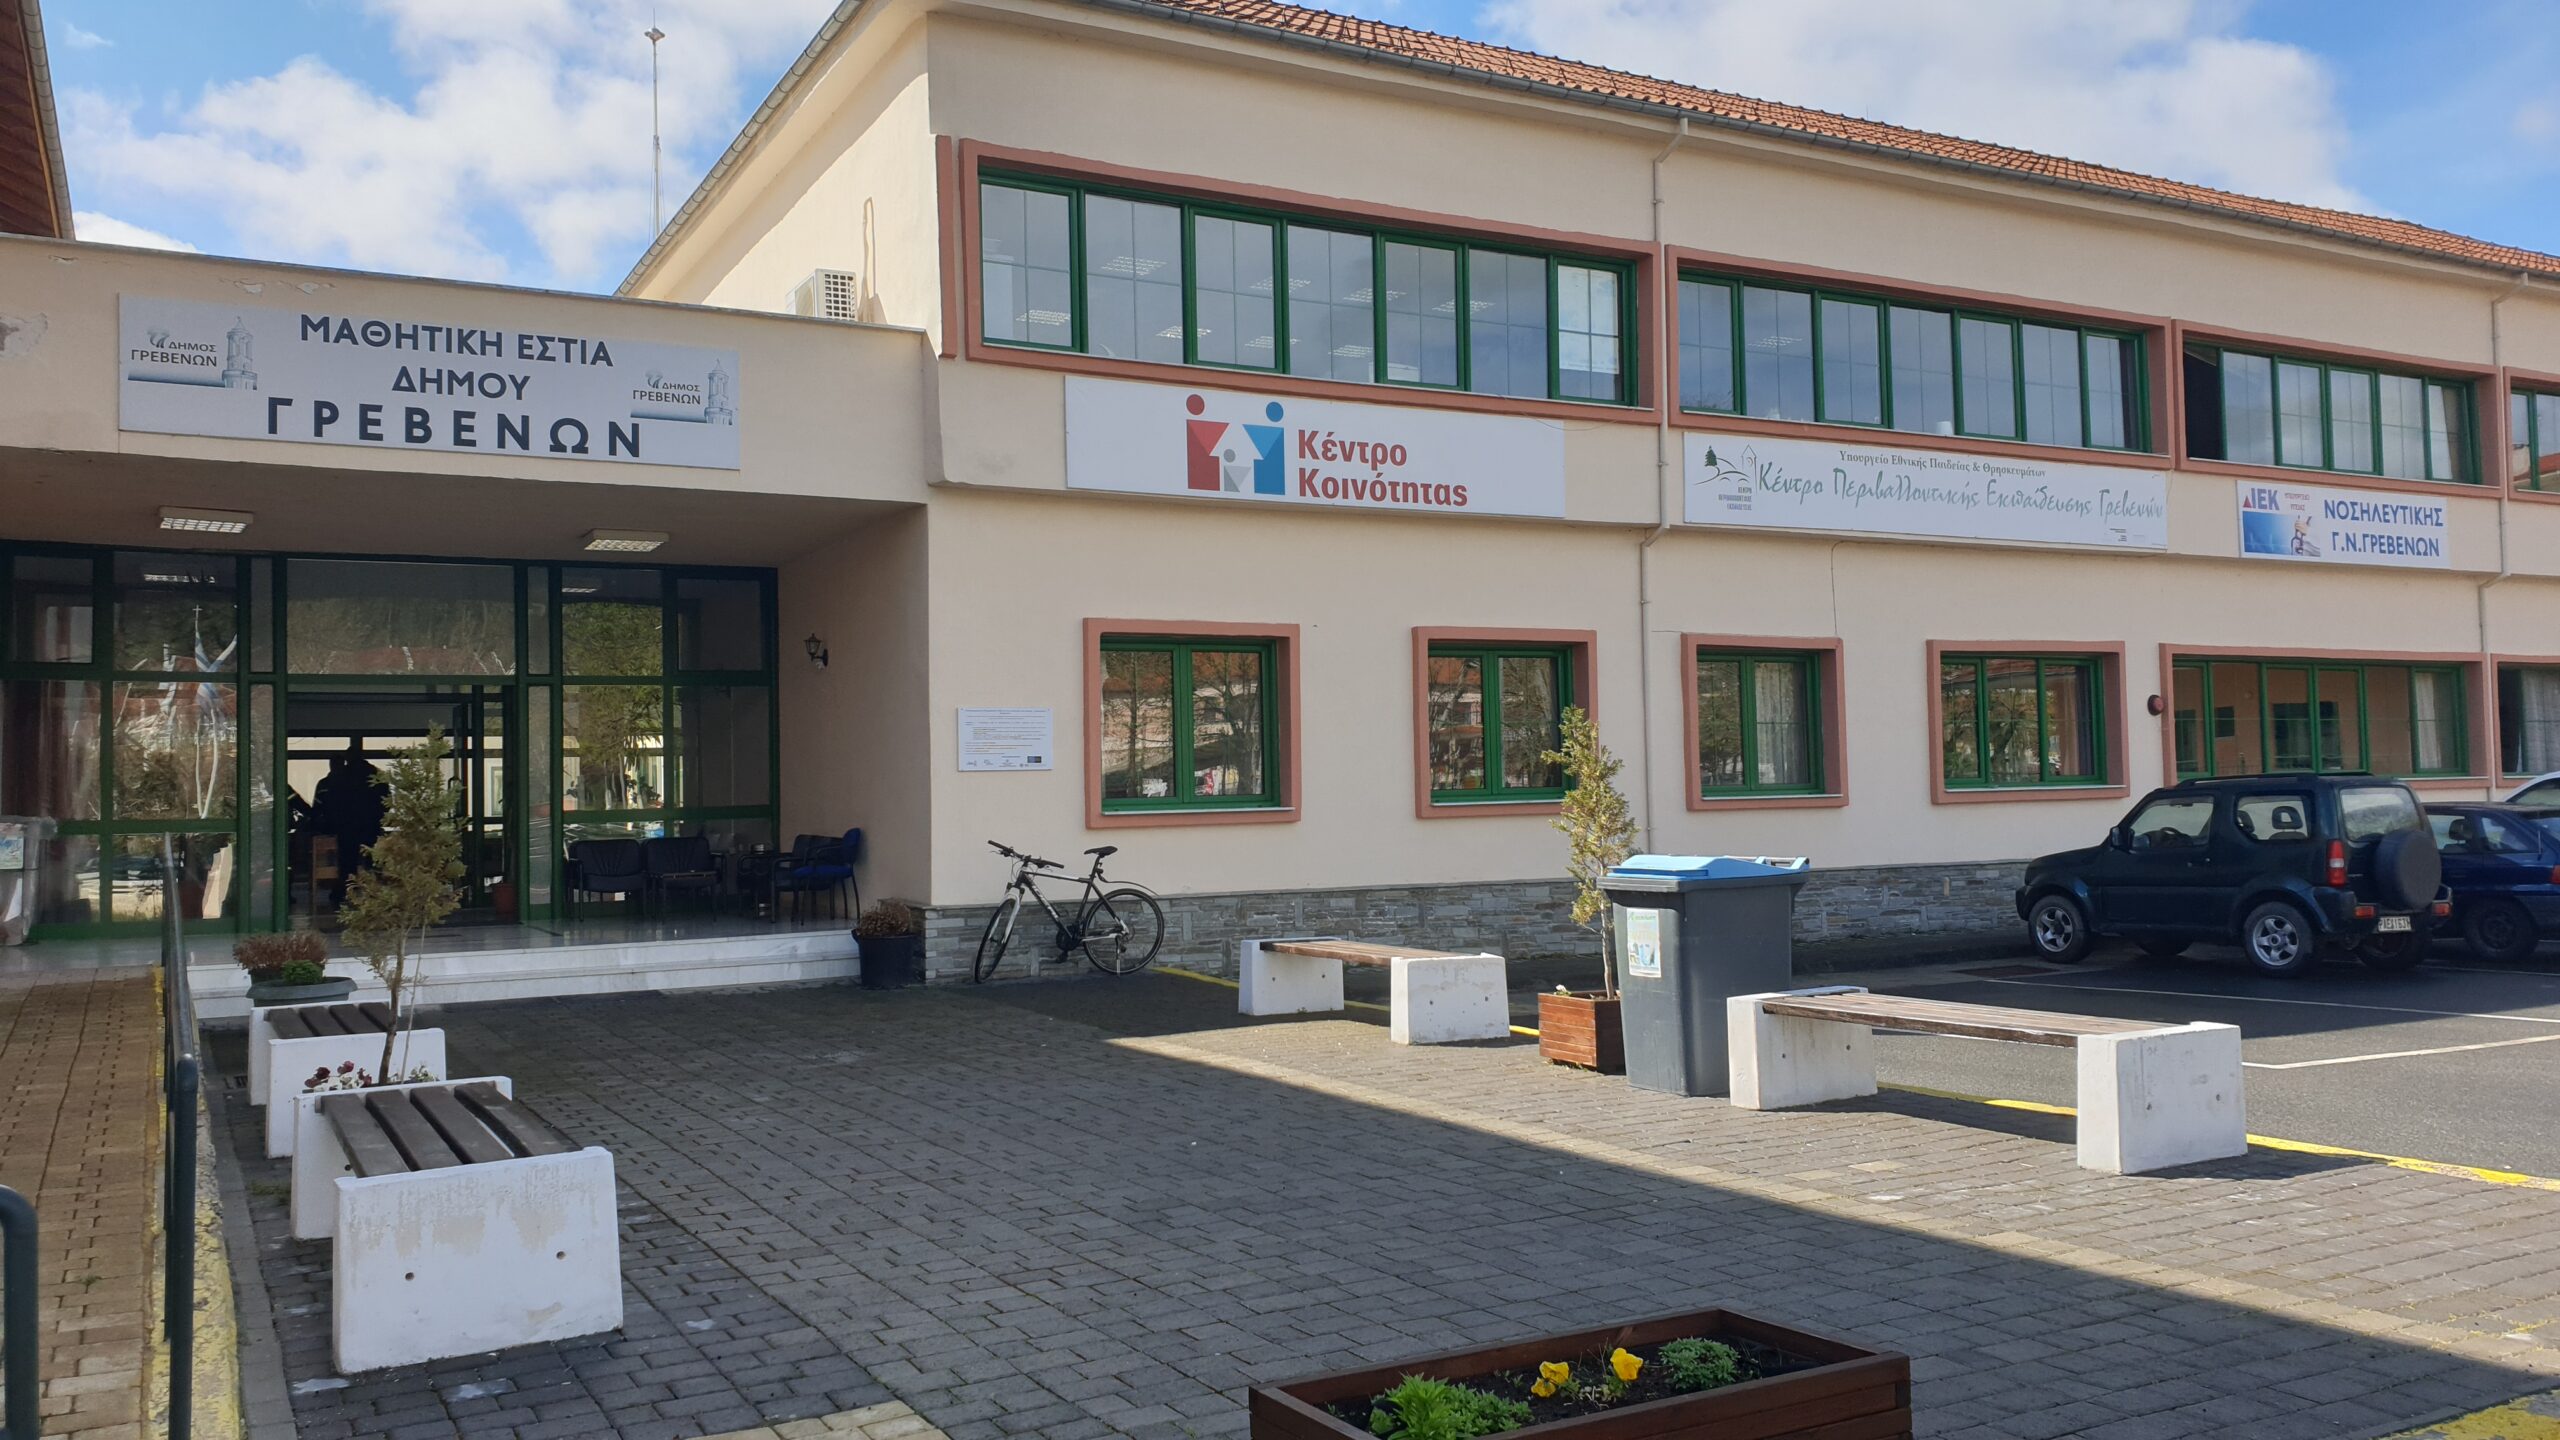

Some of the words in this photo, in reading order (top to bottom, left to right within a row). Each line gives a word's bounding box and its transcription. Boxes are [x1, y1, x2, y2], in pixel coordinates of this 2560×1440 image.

[168, 341, 217, 352] ΔΗΜΟΣ
[300, 314, 502, 357] ΜΑΘΗΤΙΚΗ
[518, 333, 614, 367] ΕΣΤΙΑ
[131, 349, 217, 367] ΓΡΕΒΕΝΩΝ
[392, 366, 531, 401] ΔΗΜΟΥ
[633, 390, 701, 405] ΓΡΕΒΕΝΩΝ
[662, 382, 701, 392] ΔΗΜΟΣ
[268, 397, 640, 458] ΓΡΕΒΕΝΩΝ
[1298, 429, 1408, 471] Κέντρο
[1840, 450, 1889, 466] Υπουργείο
[1891, 455, 1927, 469] Εθνικής
[1930, 458, 1970, 472] Παιδείας
[1972, 462, 1981, 472] &
[1982, 462, 2046, 479] Θρησκευμάτων
[1298, 467, 1468, 507] Κοινότητας
[1759, 461, 1824, 505] Κέντρο
[1833, 467, 1981, 511] Περιβαλλοντικής
[1986, 478, 2093, 519] Εκπαίδευσης
[2098, 488, 2163, 524] Γρεβενών
[2324, 499, 2443, 527] ΝΟΣΗΛΕΥΤΙΚΗΣ
[2332, 531, 2440, 557] Γ.Ν.ΓΡΕΒΕΝΩΝ
